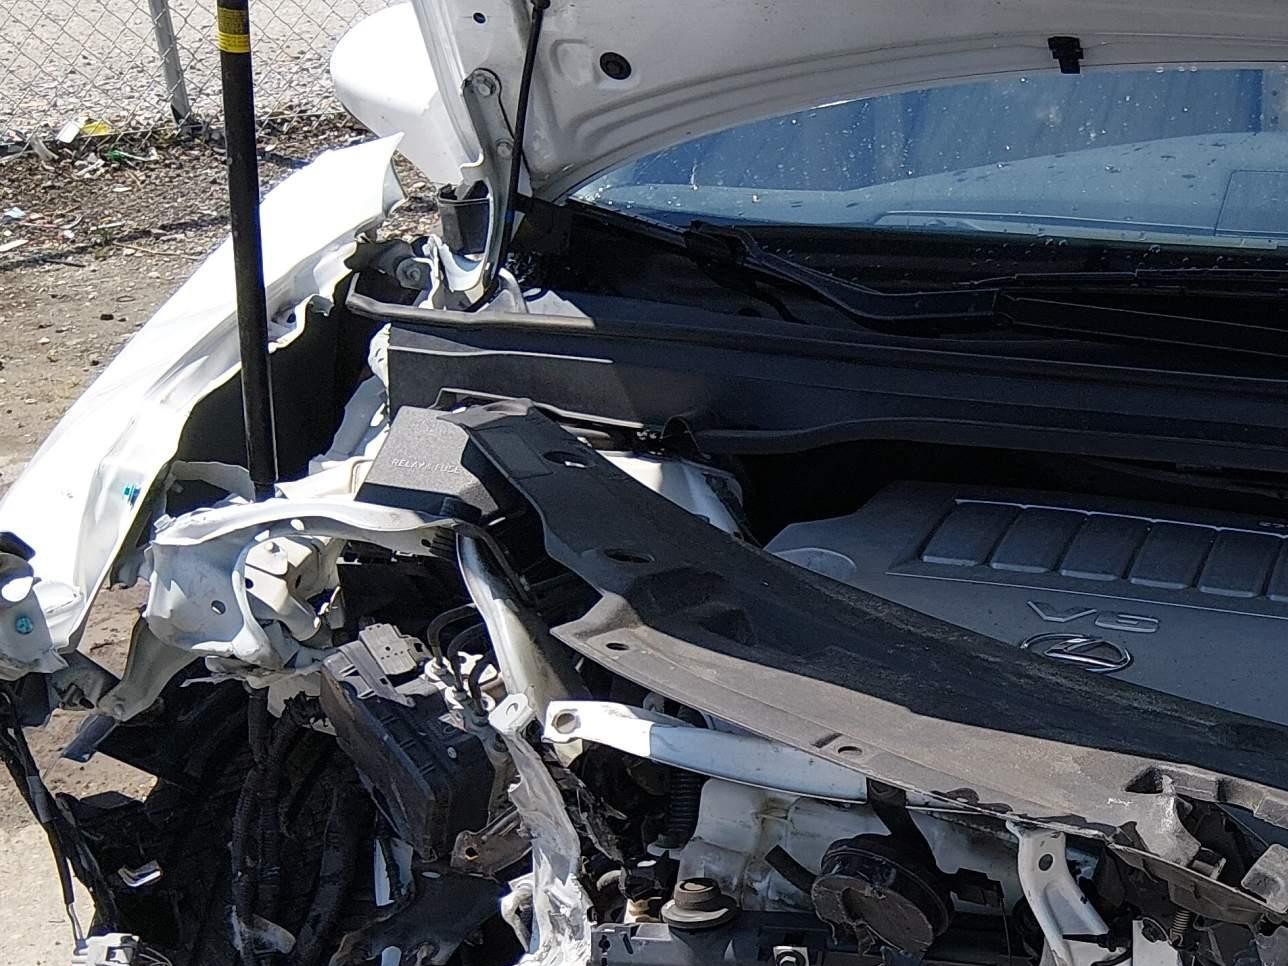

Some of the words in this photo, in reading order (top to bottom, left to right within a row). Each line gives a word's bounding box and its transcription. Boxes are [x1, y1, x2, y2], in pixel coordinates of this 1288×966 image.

[391, 458, 425, 469] RELAY
[434, 463, 462, 474] FUSE
[1027, 600, 1160, 633] V6
